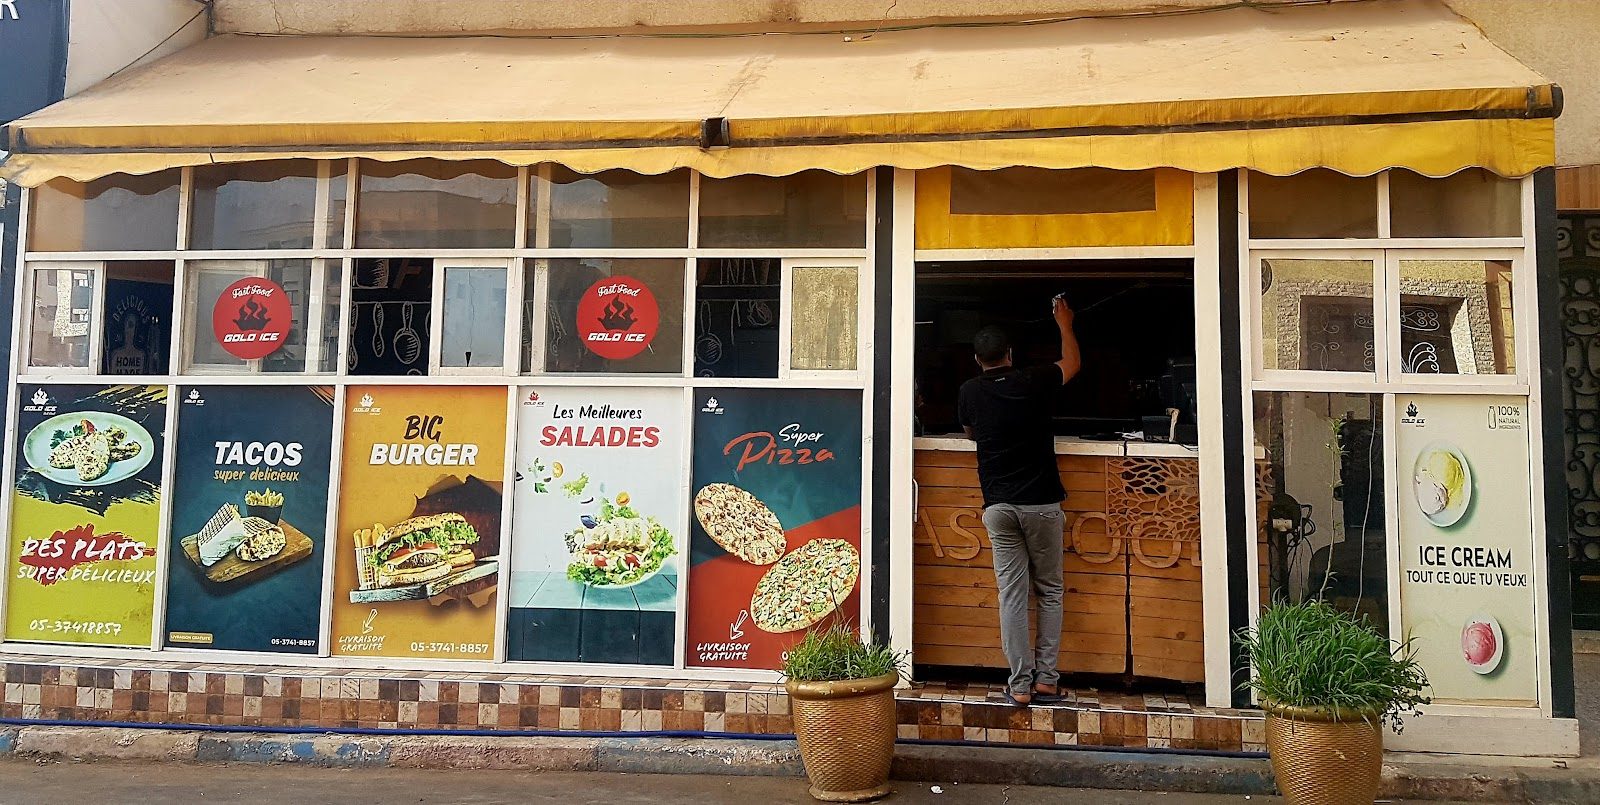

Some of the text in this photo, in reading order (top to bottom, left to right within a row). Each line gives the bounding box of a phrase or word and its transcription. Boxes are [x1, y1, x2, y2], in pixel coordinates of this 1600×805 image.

[231, 285, 274, 299] Fast Food
[597, 284, 641, 297] Fast Food
[223, 332, 280, 342] GOLD ICE
[587, 333, 646, 342] GOLD ICE
[116, 356, 141, 367] HOME
[553, 403, 643, 420] Les Meilleures
[1497, 405, 1521, 416] 100%
[403, 414, 444, 442] BIG
[1498, 417, 1521, 425] NATURAL
[539, 425, 661, 448] SALADES
[778, 423, 825, 448] Super
[214, 441, 304, 467] TACOS
[369, 443, 479, 466] BURGER
[722, 431, 835, 472] Pizza
[213, 466, 300, 483] super delicieux
[21, 537, 146, 560] DES PLATS
[1419, 545, 1512, 569] ICE CREAM
[16, 564, 155, 584] SUPER DÉLICIEUX
[1406, 570, 1527, 587] TOUT CE QUE TU VEUX!
[29, 619, 122, 636] 05-37418857
[270, 638, 315, 647] 05-3741-8857
[338, 634, 386, 644] LIVRAISON
[341, 642, 384, 652] GRATUITE
[410, 641, 489, 654] 05-3741-8857
[696, 642, 751, 652] LIVRAISON
[699, 651, 749, 662] GRATUITE
